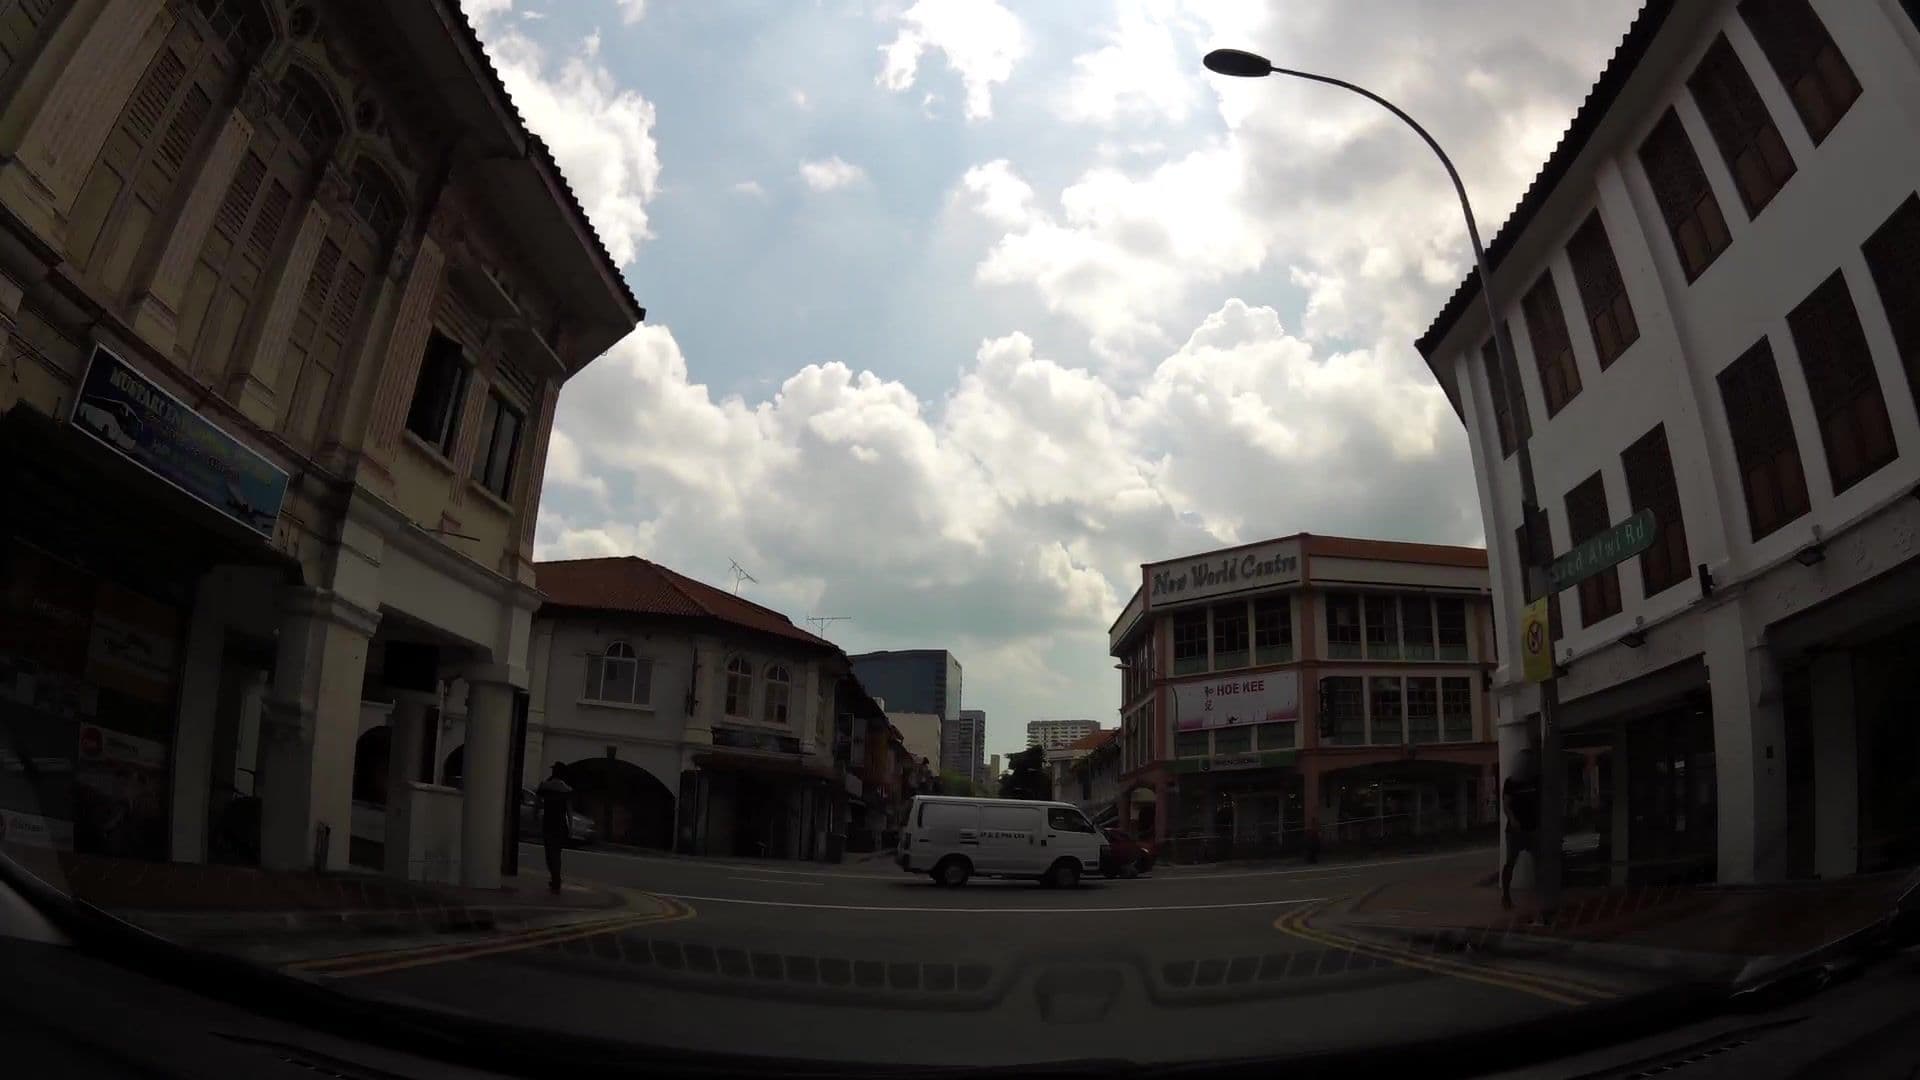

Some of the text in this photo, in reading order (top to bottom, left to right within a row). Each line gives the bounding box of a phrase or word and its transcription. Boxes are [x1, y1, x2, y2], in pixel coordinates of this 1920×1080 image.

[1625, 519, 1644, 544] Rd
[1152, 554, 1297, 595] New World Centre
[1217, 680, 1265, 697] HOE KEE
